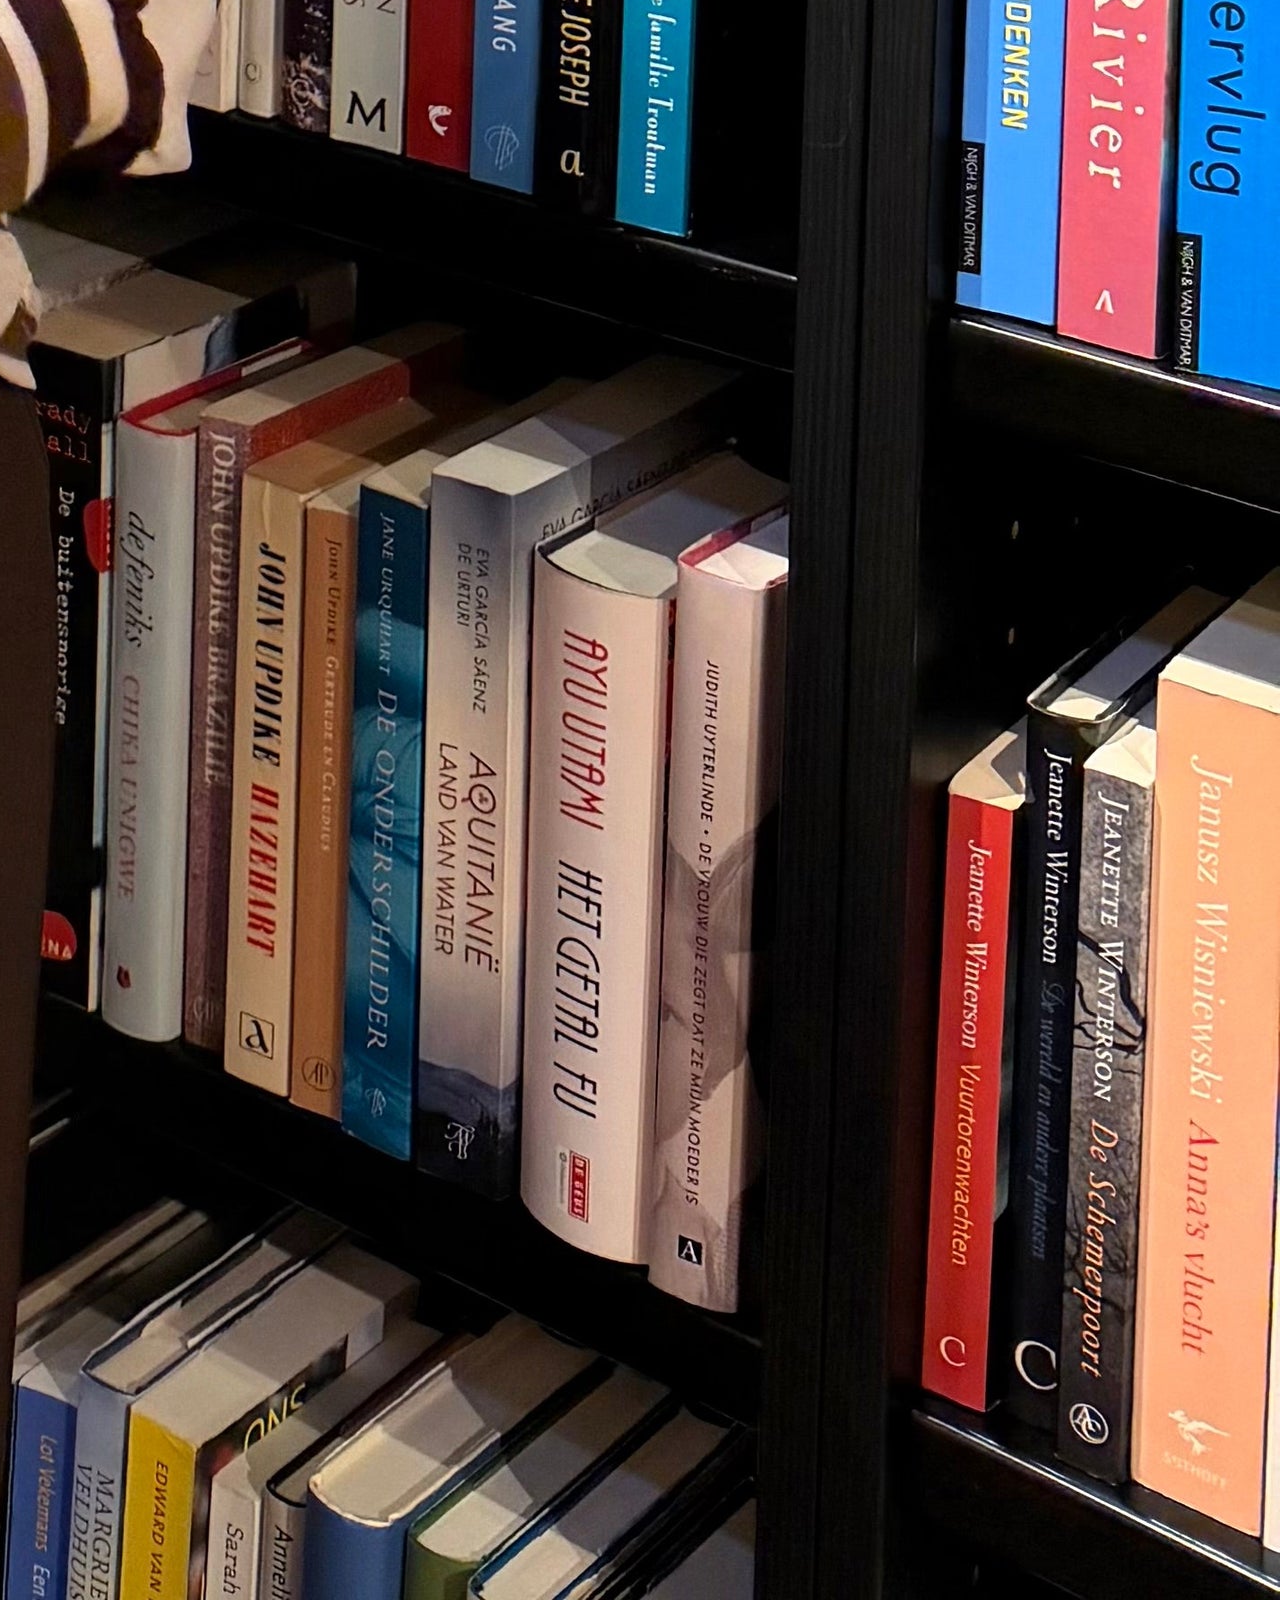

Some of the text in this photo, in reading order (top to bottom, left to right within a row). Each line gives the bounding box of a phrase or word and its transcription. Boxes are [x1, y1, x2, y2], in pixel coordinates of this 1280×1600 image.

[557, 9, 591, 108] JOSEPH
[246, 542, 287, 959] JOHN UPDIKE HAZEHART
[364, 513, 399, 1051] JANE URQUHART DE ONDERSCHILDER
[433, 741, 459, 957] LAND VAN WATER
[1189, 754, 1234, 886] Janusz
[462, 750, 500, 975] AQUITANIË
[552, 628, 610, 1120] AYU UTAMI HET GETAL FU
[951, 840, 992, 1266] Jeanette Winterson Vuurtorenwachten
[1188, 899, 1230, 1103] Wisniewski
[1087, 1118, 1120, 1161] De
[1077, 1170, 1117, 1378] Schemerpoort
[1180, 1252, 1218, 1357] vlucht
[148, 1461, 168, 1592] EDWARD VAN
[222, 1522, 244, 1595] Sarah
